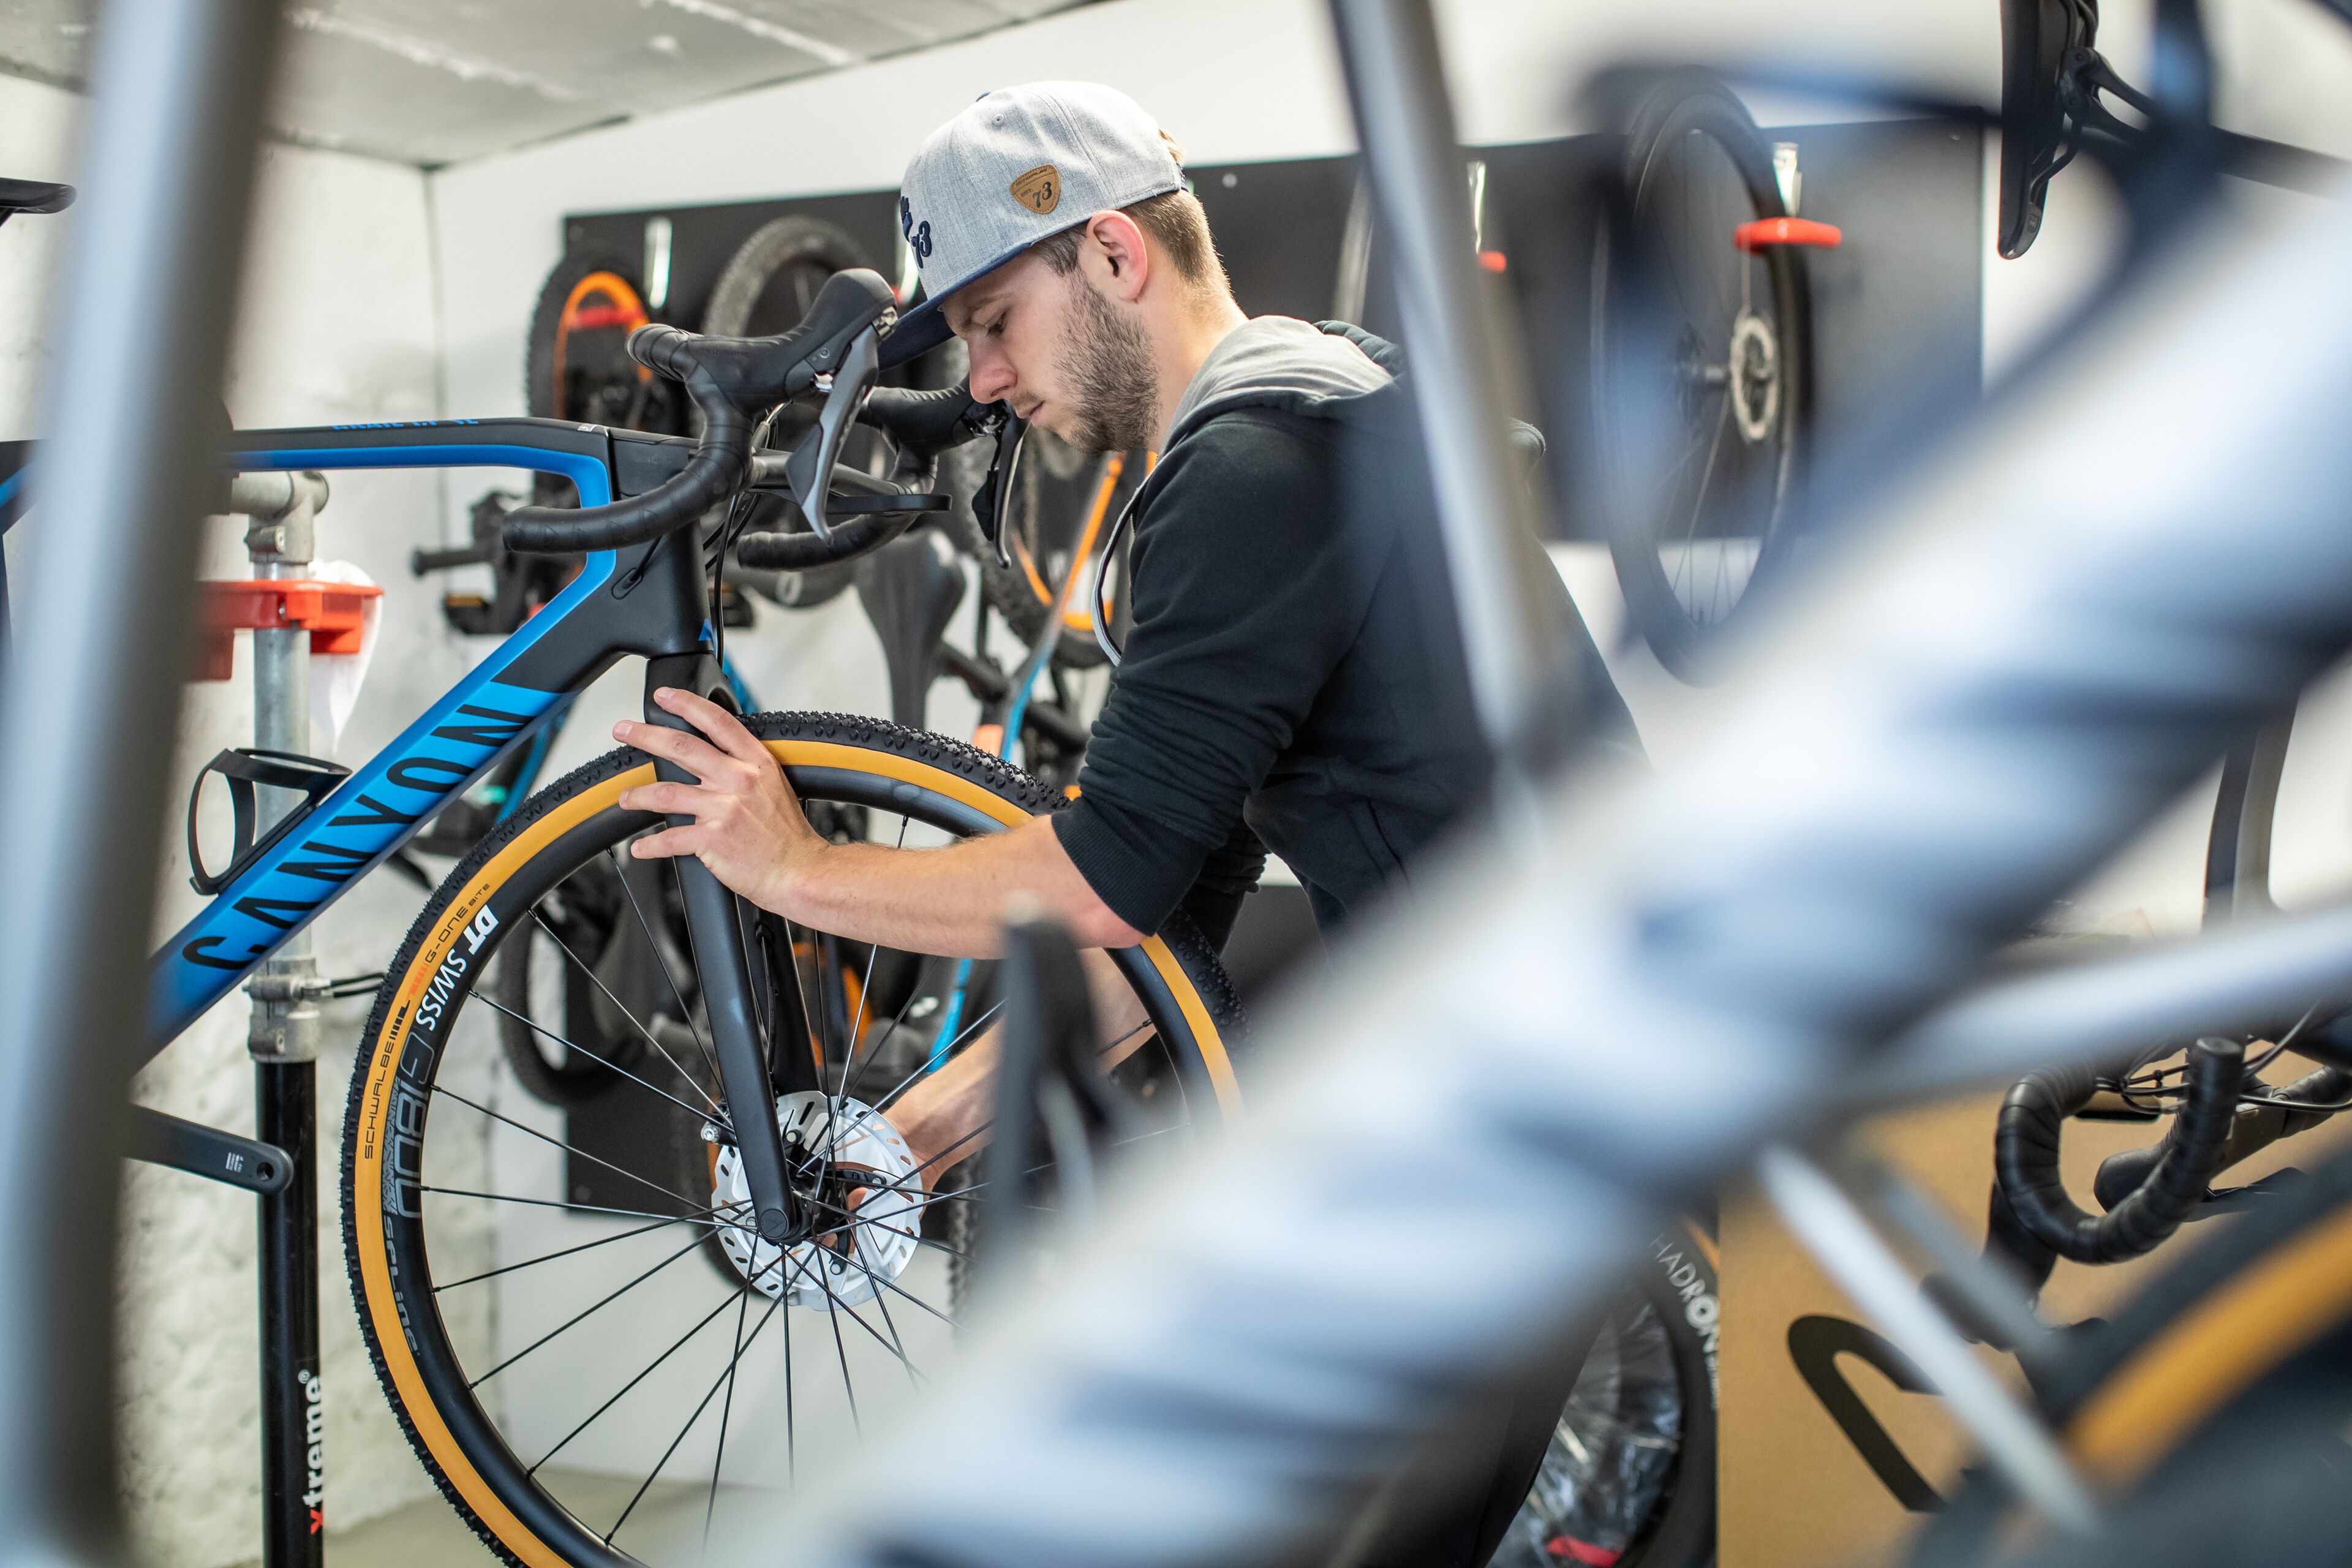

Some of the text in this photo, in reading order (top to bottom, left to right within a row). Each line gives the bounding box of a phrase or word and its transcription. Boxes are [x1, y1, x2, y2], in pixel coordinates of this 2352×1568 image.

[1032, 181, 1052, 208] 73
[911, 220, 932, 269] 73
[182, 703, 538, 971] CANYON
[415, 904, 499, 1031] DT SWISS
[424, 883, 490, 963] G-ONE BITE
[364, 1040, 394, 1159] SCHWALBE
